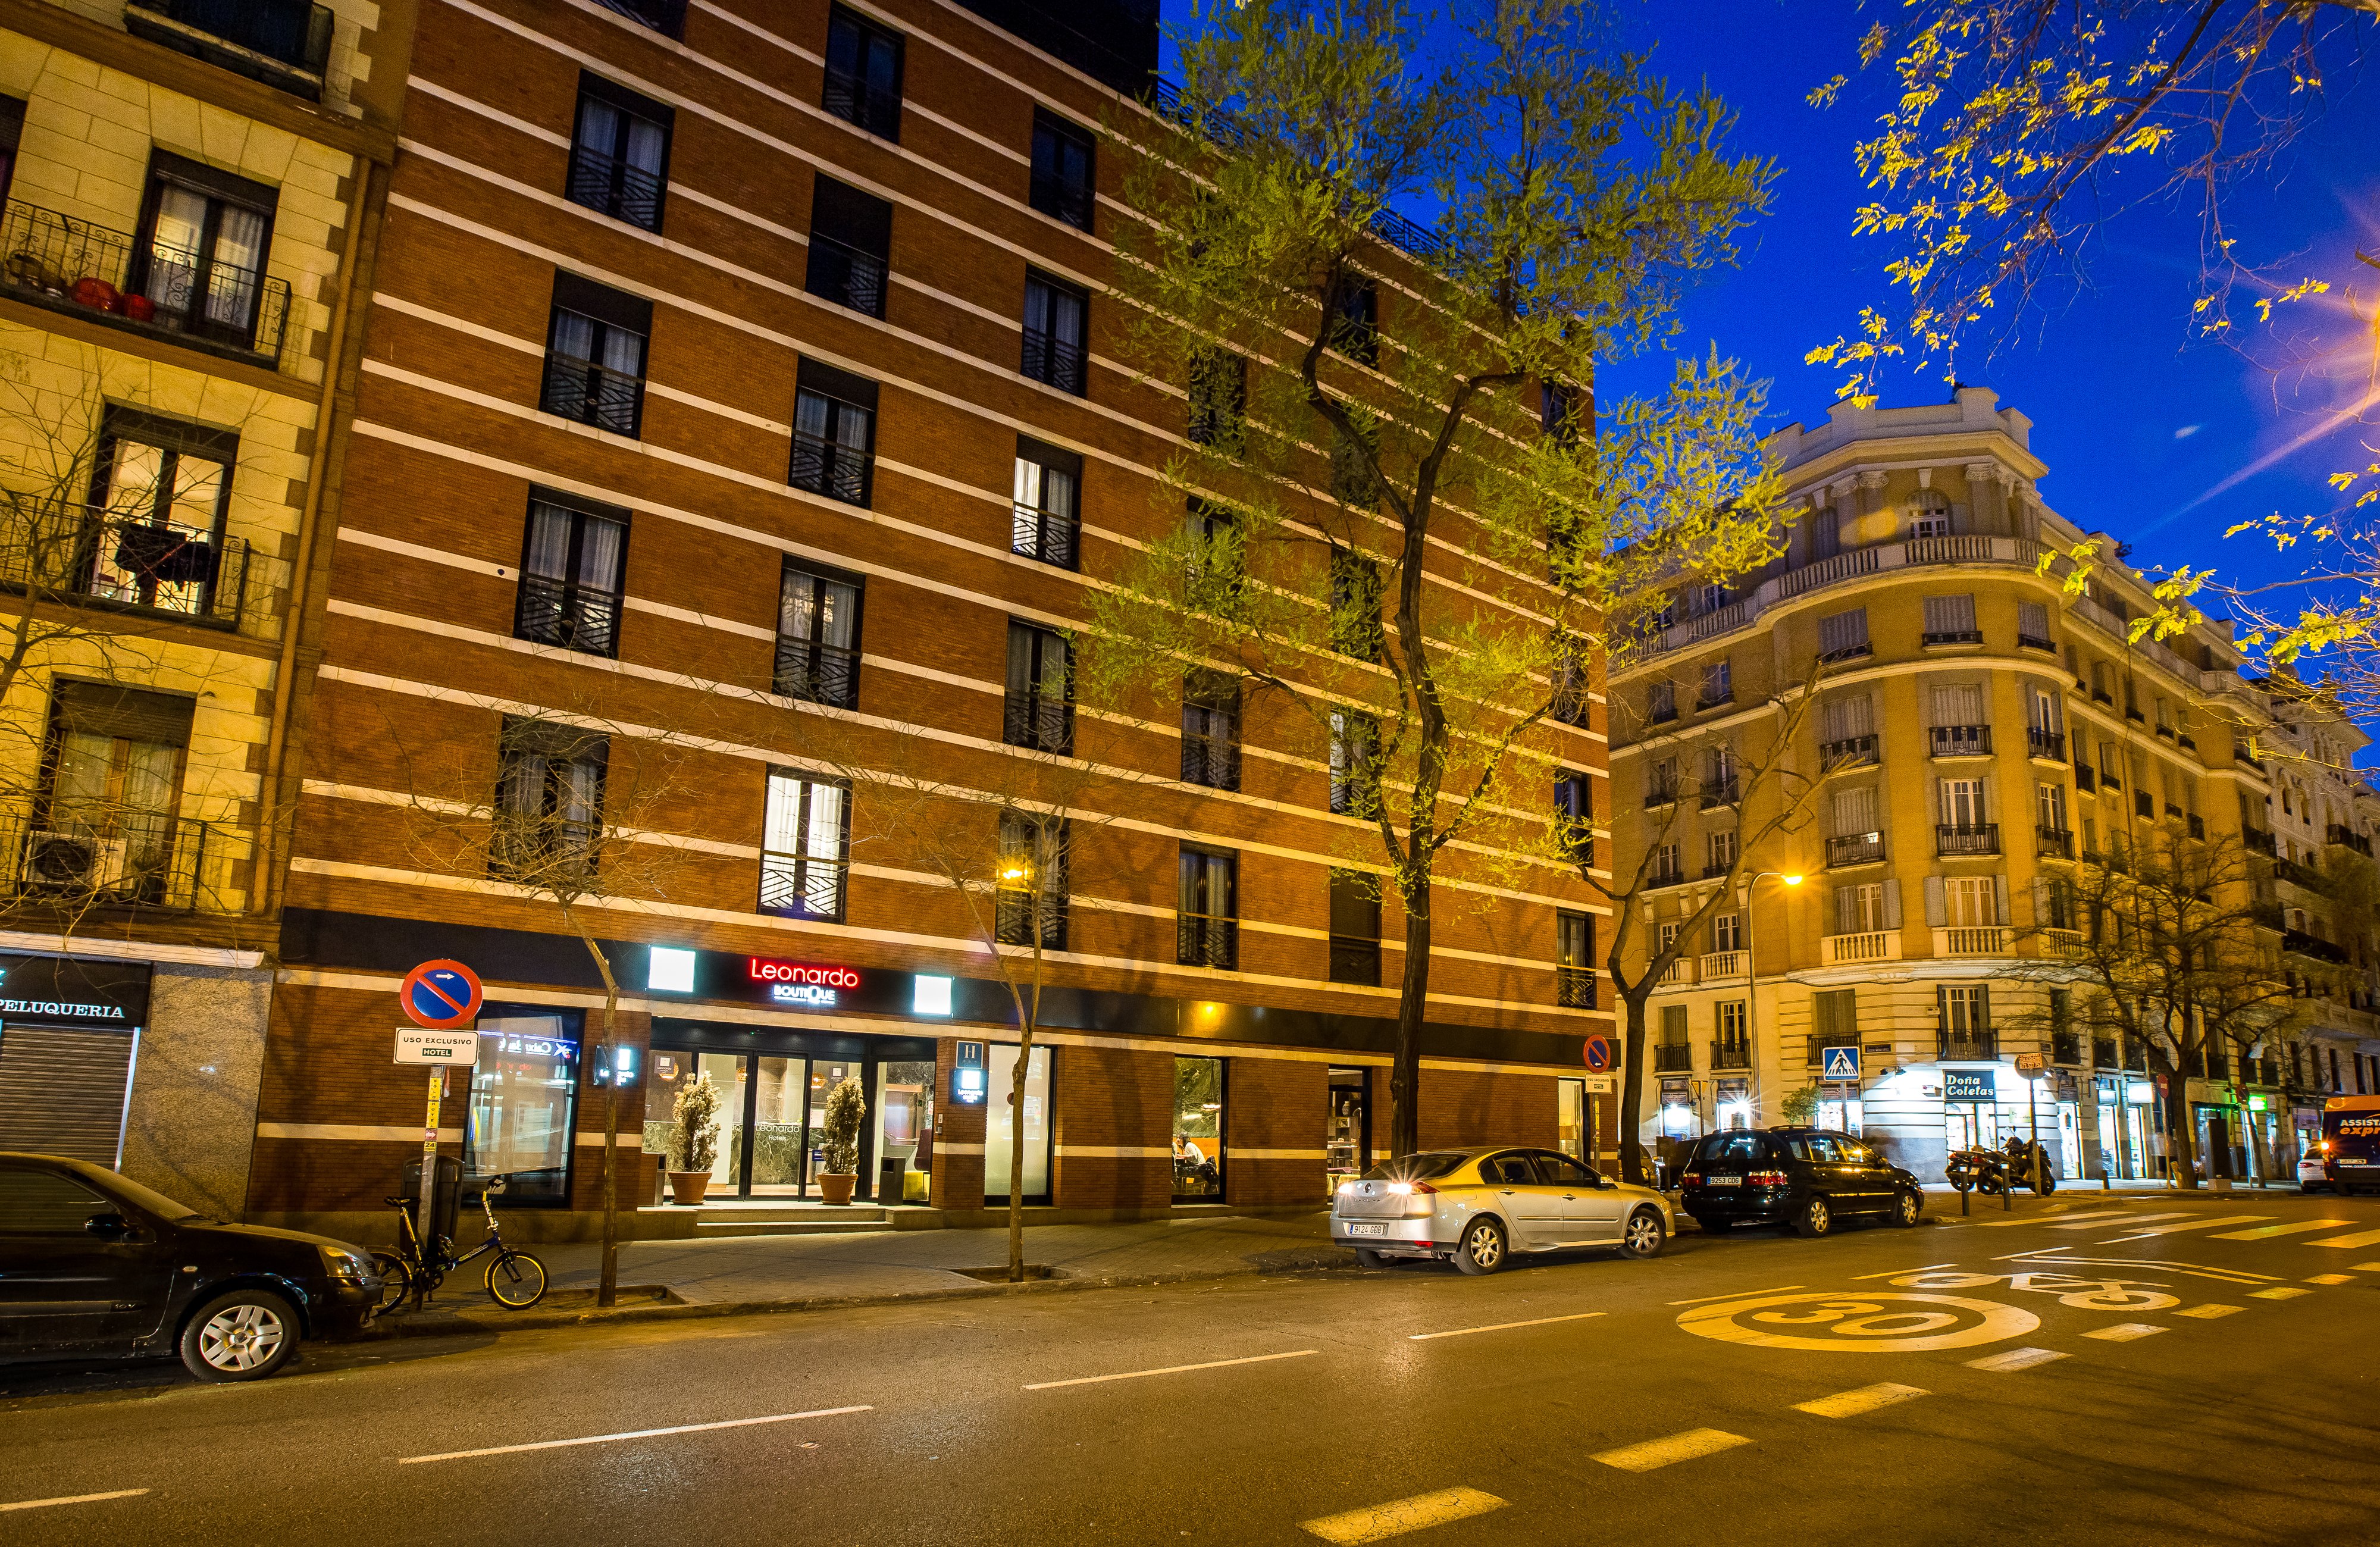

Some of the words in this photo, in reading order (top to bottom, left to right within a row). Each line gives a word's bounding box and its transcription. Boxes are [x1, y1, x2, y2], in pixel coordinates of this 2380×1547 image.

[751, 959, 859, 988] Leonardo
[774, 985, 835, 1004] BOUTIQUE
[0, 999, 125, 1018] ELUQUERIA
[964, 1045, 976, 1059] H
[1946, 1075, 1980, 1085] Doña
[1946, 1085, 1994, 1095] Coletas
[756, 1124, 800, 1133] Leonardo
[1752, 1302, 1959, 1335] 30
